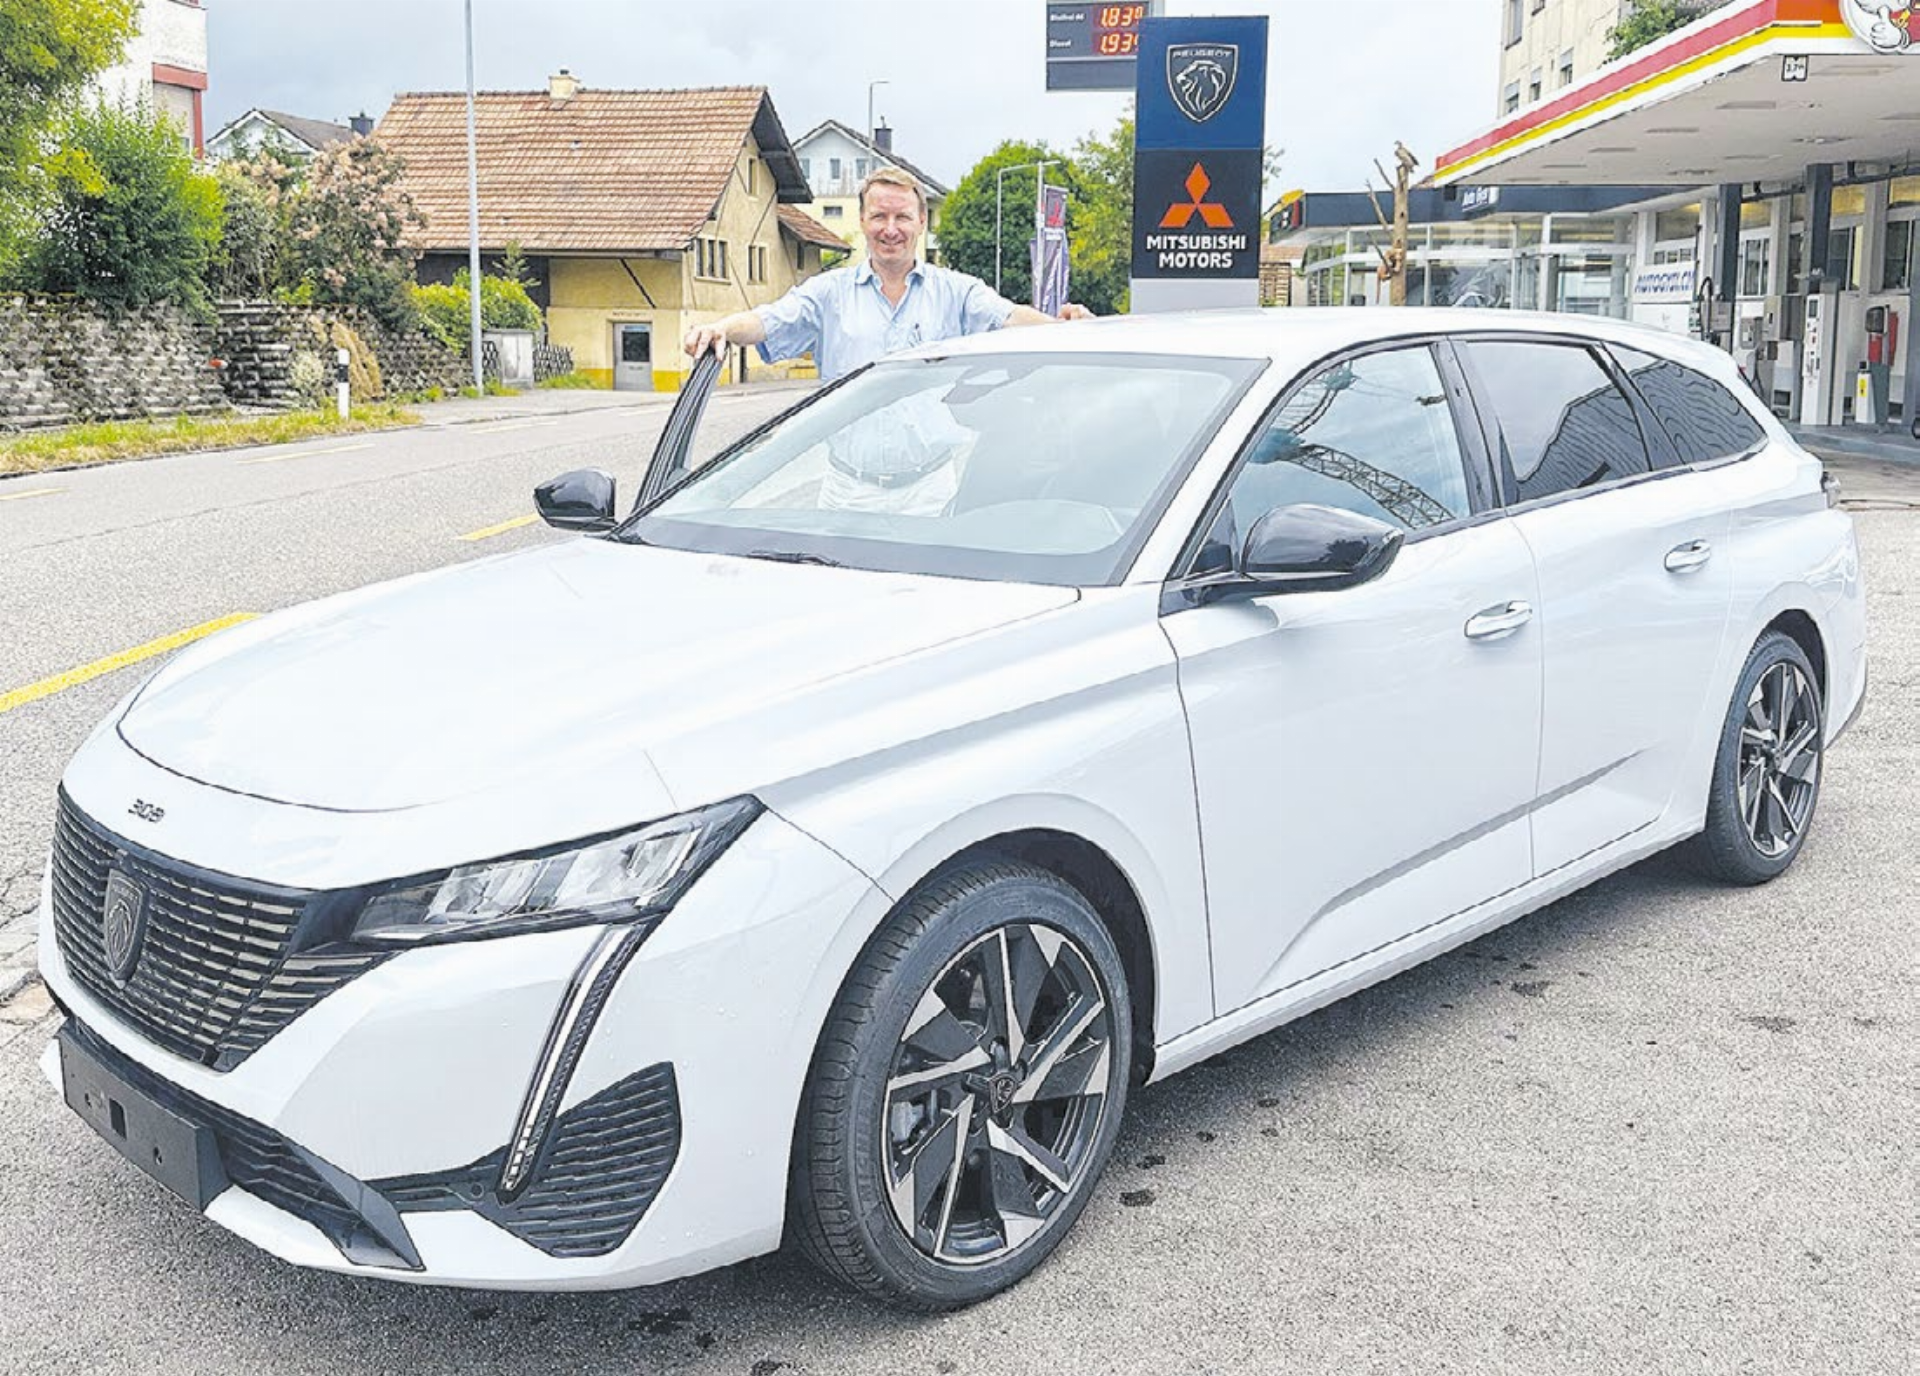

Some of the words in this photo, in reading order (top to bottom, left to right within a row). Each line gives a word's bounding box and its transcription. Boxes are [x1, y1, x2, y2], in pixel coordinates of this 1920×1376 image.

[1173, 49, 1232, 58] PEUGEOT
[1146, 234, 1246, 250] MITSUBISHI
[1158, 251, 1233, 268] MOTORS
[128, 798, 165, 823] 308
